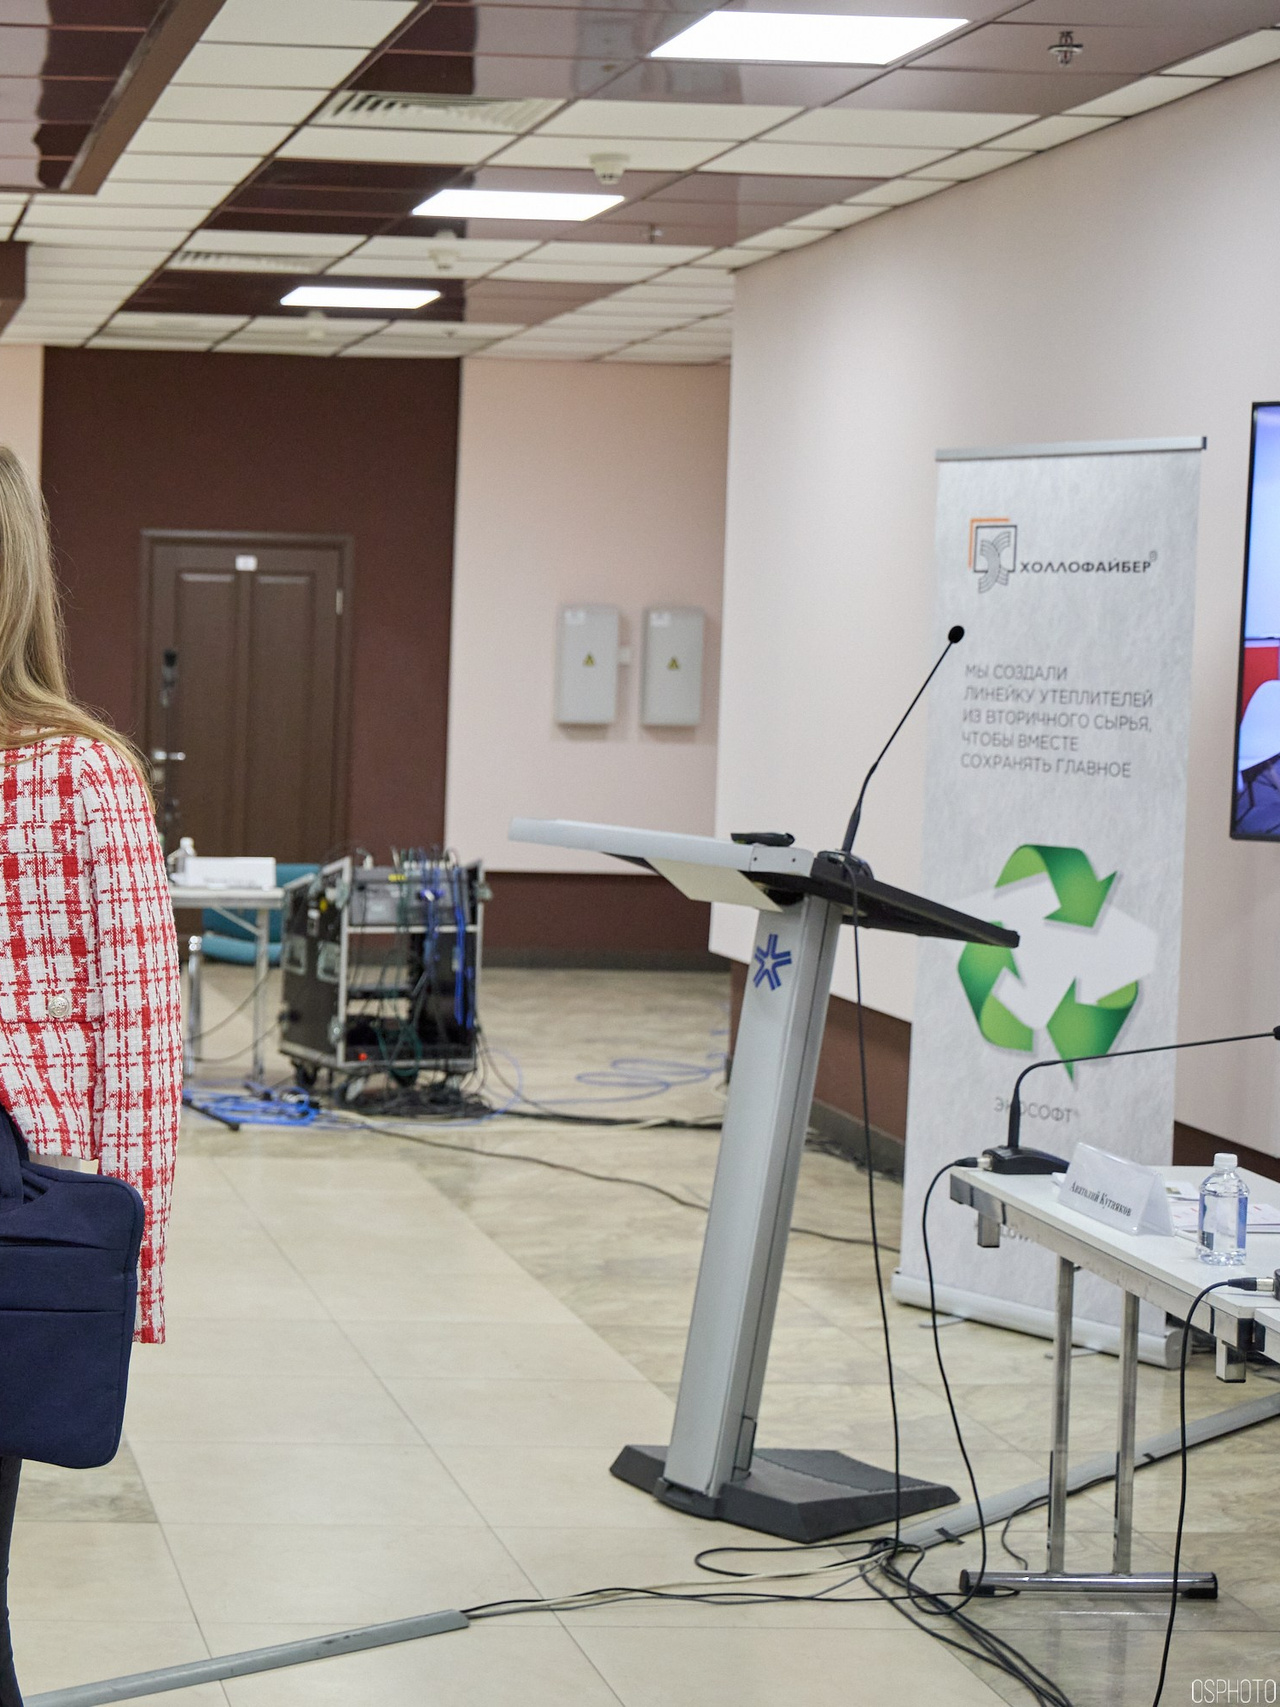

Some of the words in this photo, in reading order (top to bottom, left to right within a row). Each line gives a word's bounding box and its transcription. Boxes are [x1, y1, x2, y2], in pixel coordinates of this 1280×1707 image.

[965, 664, 988, 679] МЫ
[993, 664, 1067, 681] СОЗДАЛИ
[964, 685, 1035, 704] ЛИНЕЙКУ
[1039, 689, 1153, 708] УТЕПЛИТЕЛЕЙ
[962, 708, 981, 723] ИЗ
[986, 709, 1089, 729] ВТОРИЧНОГО
[1094, 714, 1152, 732] СЫРЬЯ,
[961, 731, 1014, 748] ЧТОБЫ
[1018, 733, 1079, 751] ВМЕСТЕ
[960, 753, 1052, 773] СОХРАНЯТЬ
[1055, 758, 1132, 778] ГЛАВНОЕ
